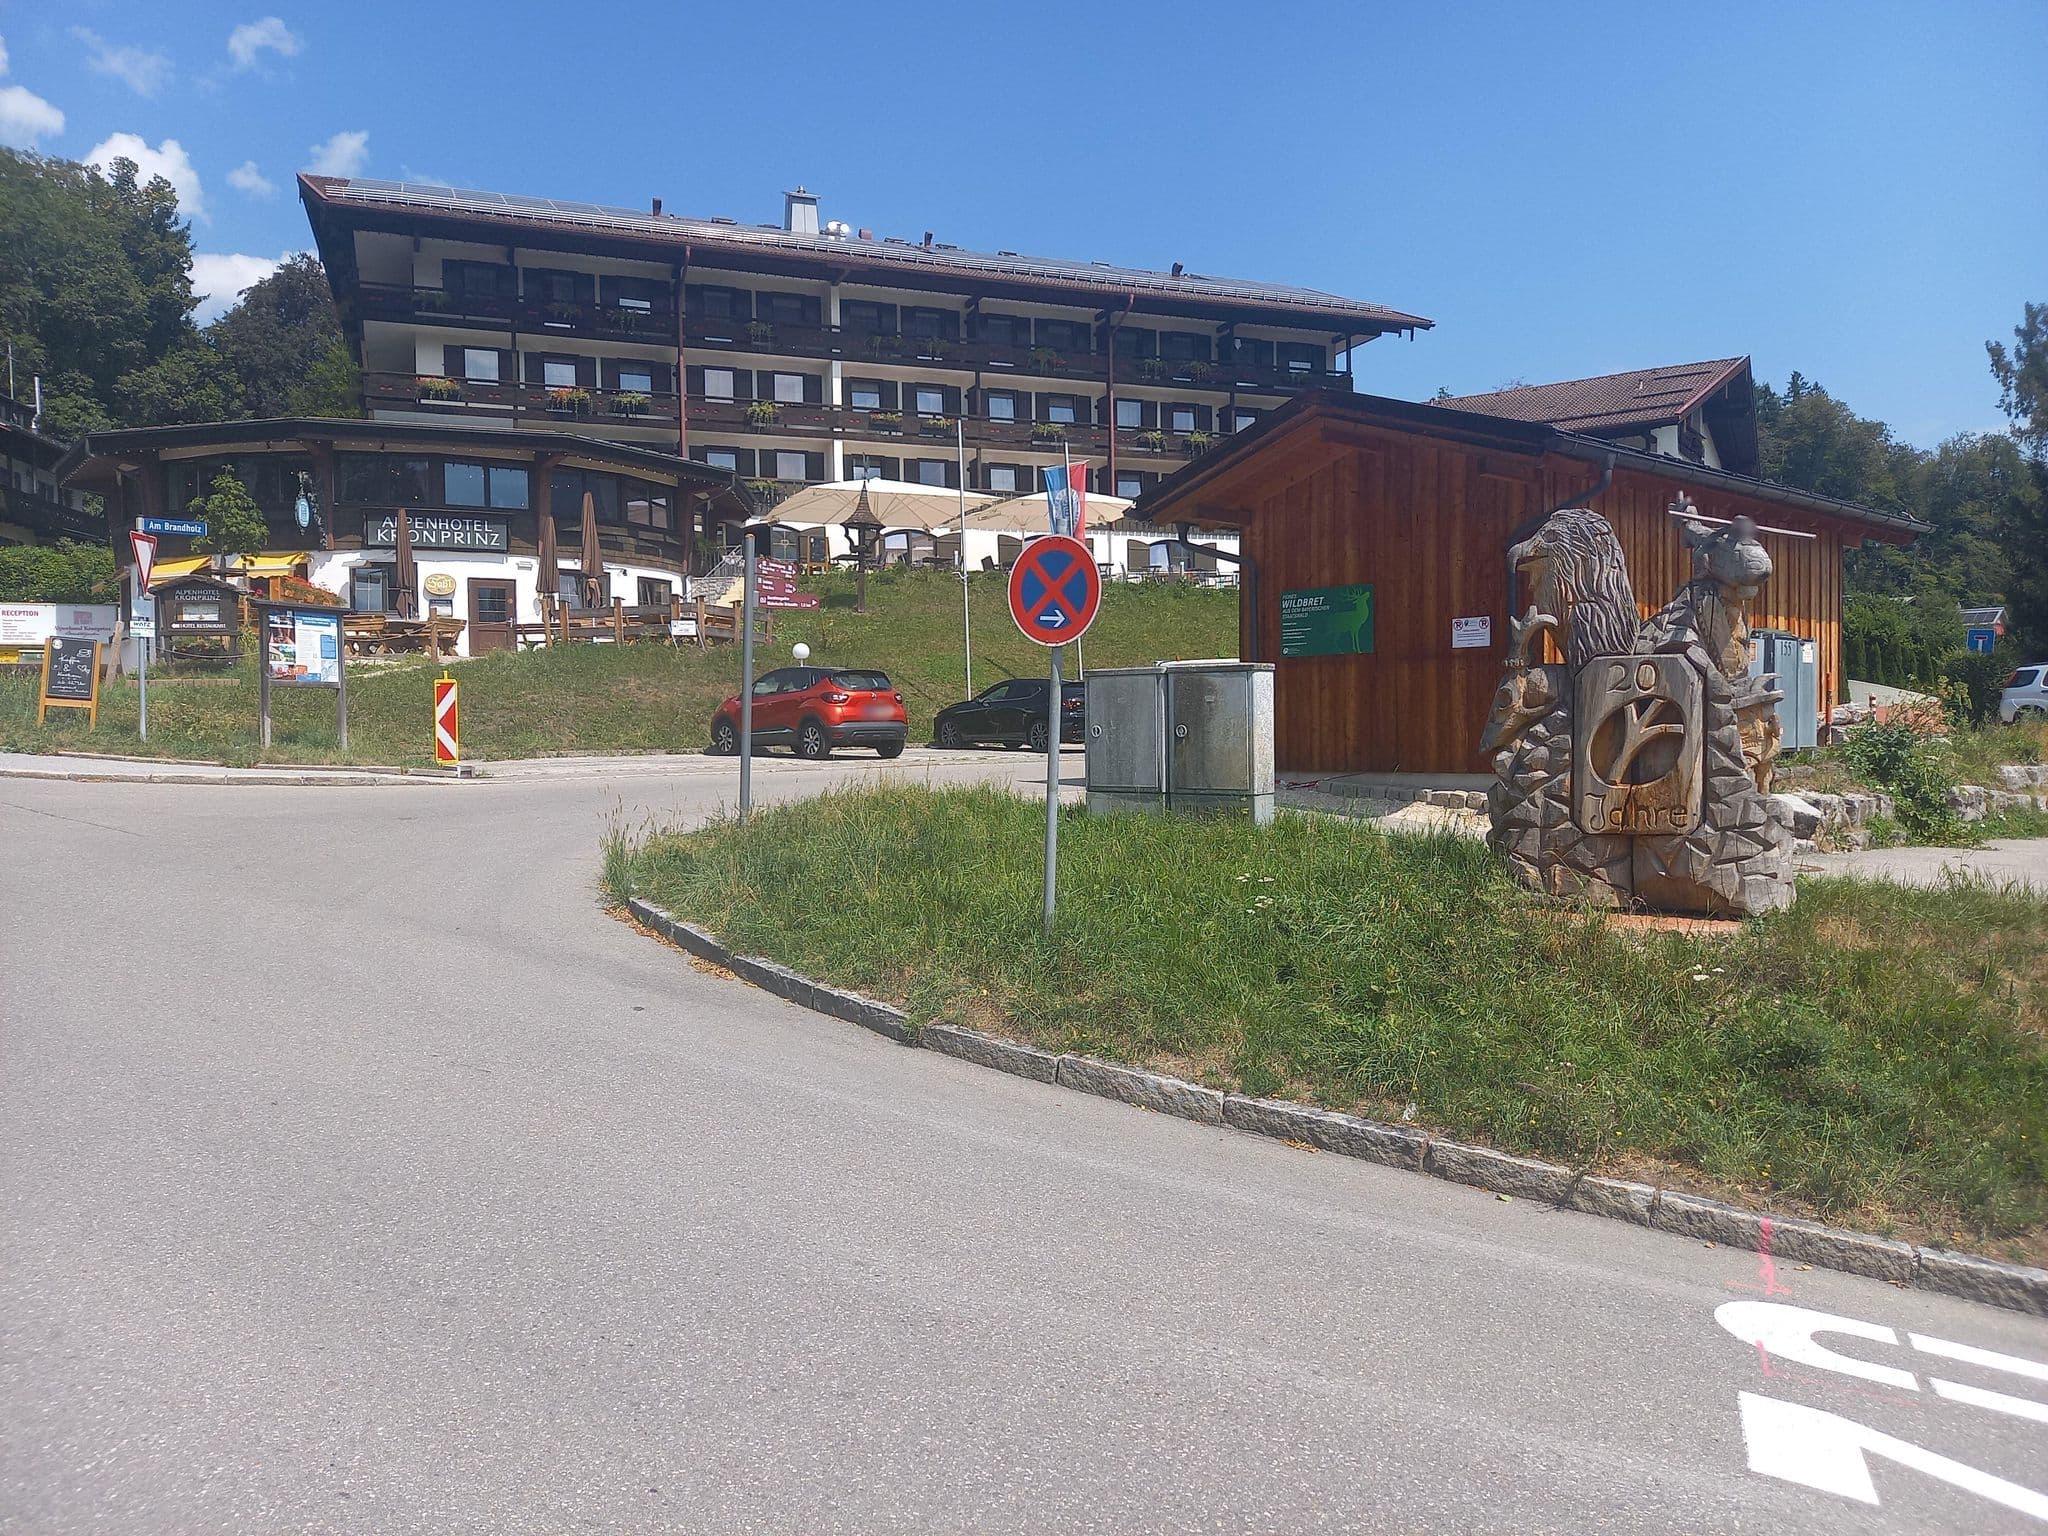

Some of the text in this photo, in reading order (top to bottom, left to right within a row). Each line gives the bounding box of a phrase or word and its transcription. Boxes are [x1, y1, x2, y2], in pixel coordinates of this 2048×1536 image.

[149, 521, 202, 533] Am Brandholz
[1282, 596, 1325, 609] WILDBRET
[1780, 641, 1792, 657] 155
[1605, 661, 1658, 694] 20
[1584, 793, 1689, 833] Jahre
